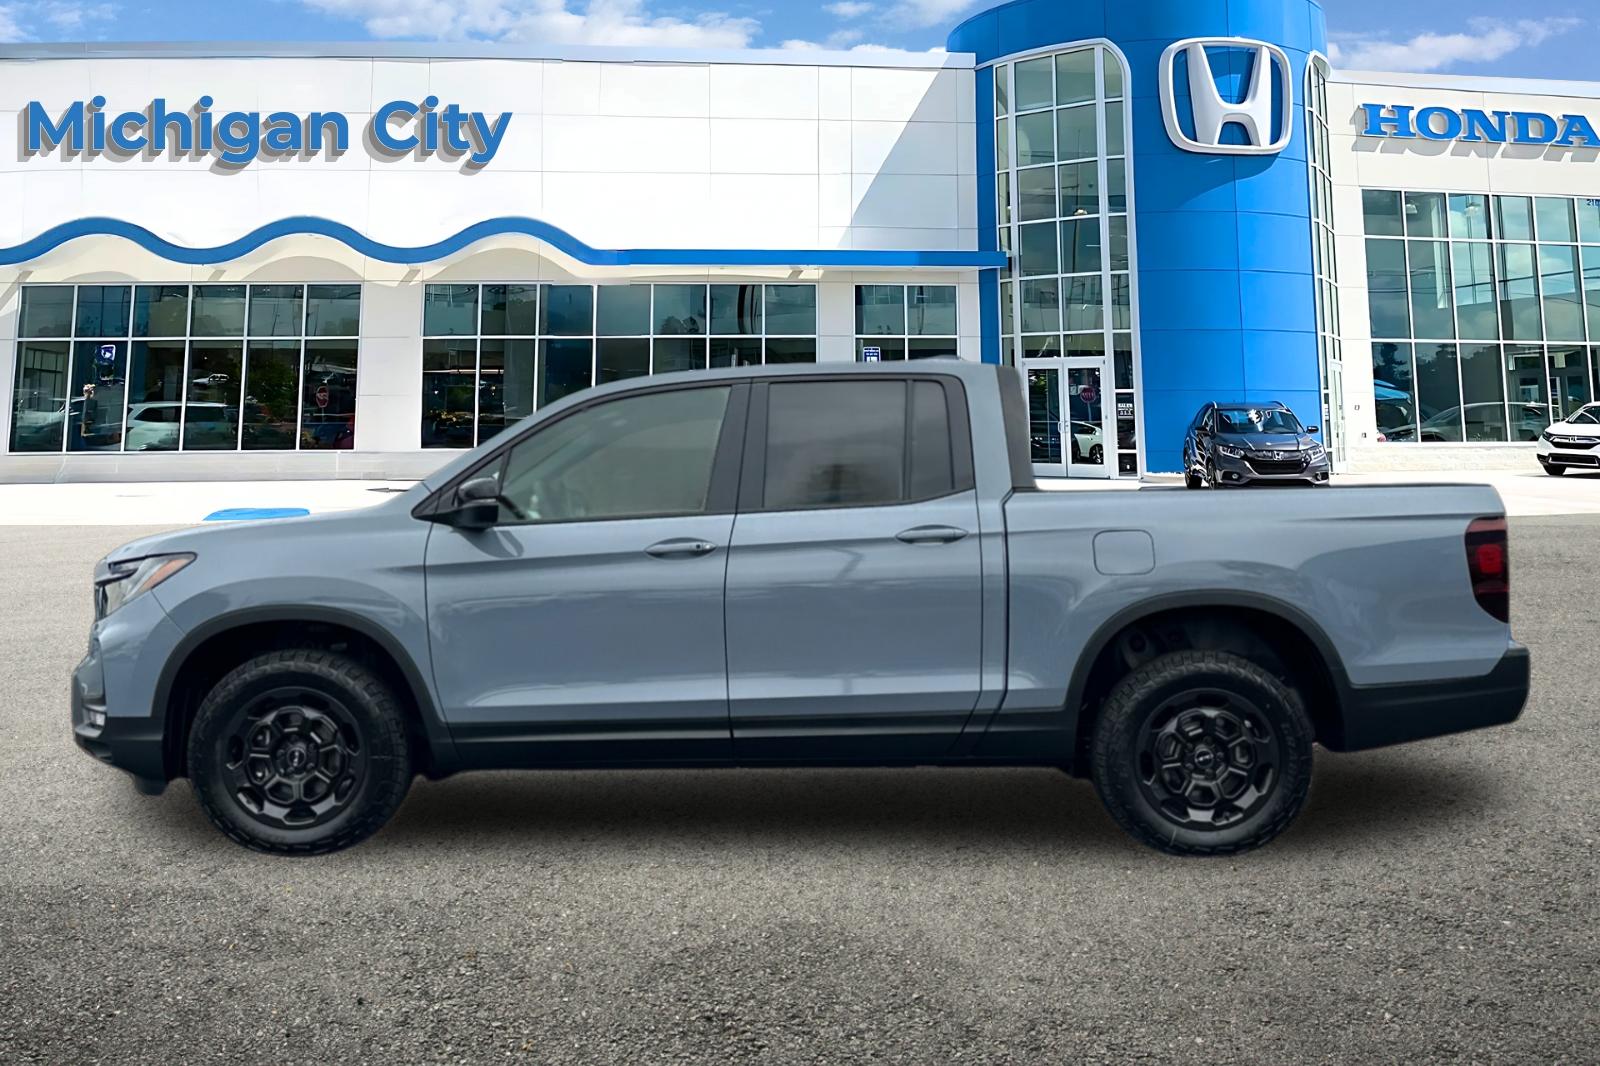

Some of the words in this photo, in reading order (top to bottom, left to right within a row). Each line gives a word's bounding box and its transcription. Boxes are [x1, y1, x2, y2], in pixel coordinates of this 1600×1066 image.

[28, 95, 349, 164] Michigan
[374, 95, 513, 164] City
[1361, 103, 1600, 148] HONDA
